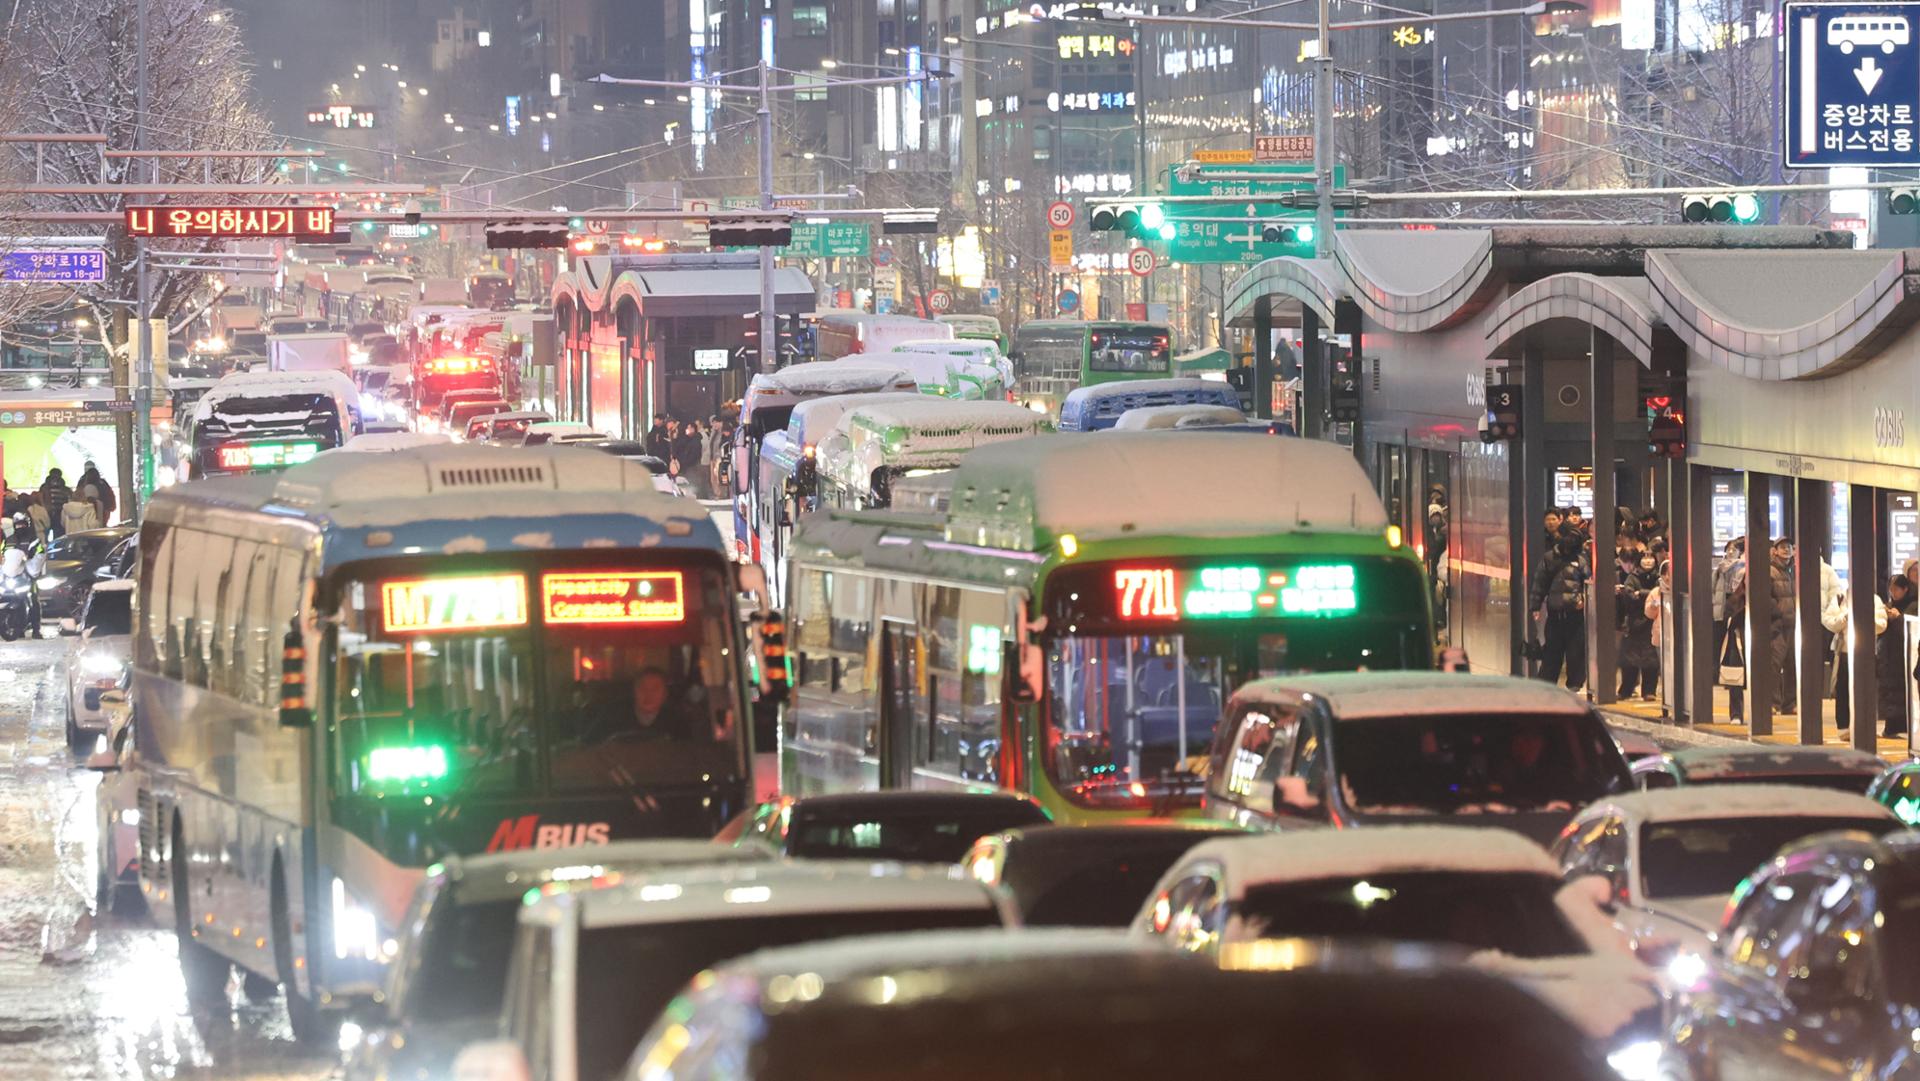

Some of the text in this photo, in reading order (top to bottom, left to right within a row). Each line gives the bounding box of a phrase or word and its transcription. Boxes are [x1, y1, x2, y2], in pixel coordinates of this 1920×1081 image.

[1822, 103, 1914, 126] 중앙차로
[1823, 129, 1914, 152] 버스전용
[131, 209, 333, 234] 니 유의하시기 바
[1054, 210, 1070, 222] 50
[1178, 222, 1219, 238] 홍익대
[30, 254, 101, 269] 양화로18길
[1134, 254, 1150, 270] 50
[1240, 252, 1263, 261] 200m
[73, 269, 101, 280] 18-gil
[933, 296, 949, 307] 50
[1237, 374, 1245, 386] 1
[1345, 379, 1354, 392] 2
[1500, 392, 1511, 406] 3
[33, 411, 75, 424] 홍대입구
[1663, 406, 1674, 420] 4
[1115, 568, 1178, 617] 7711
[535, 822, 611, 850] BUS
